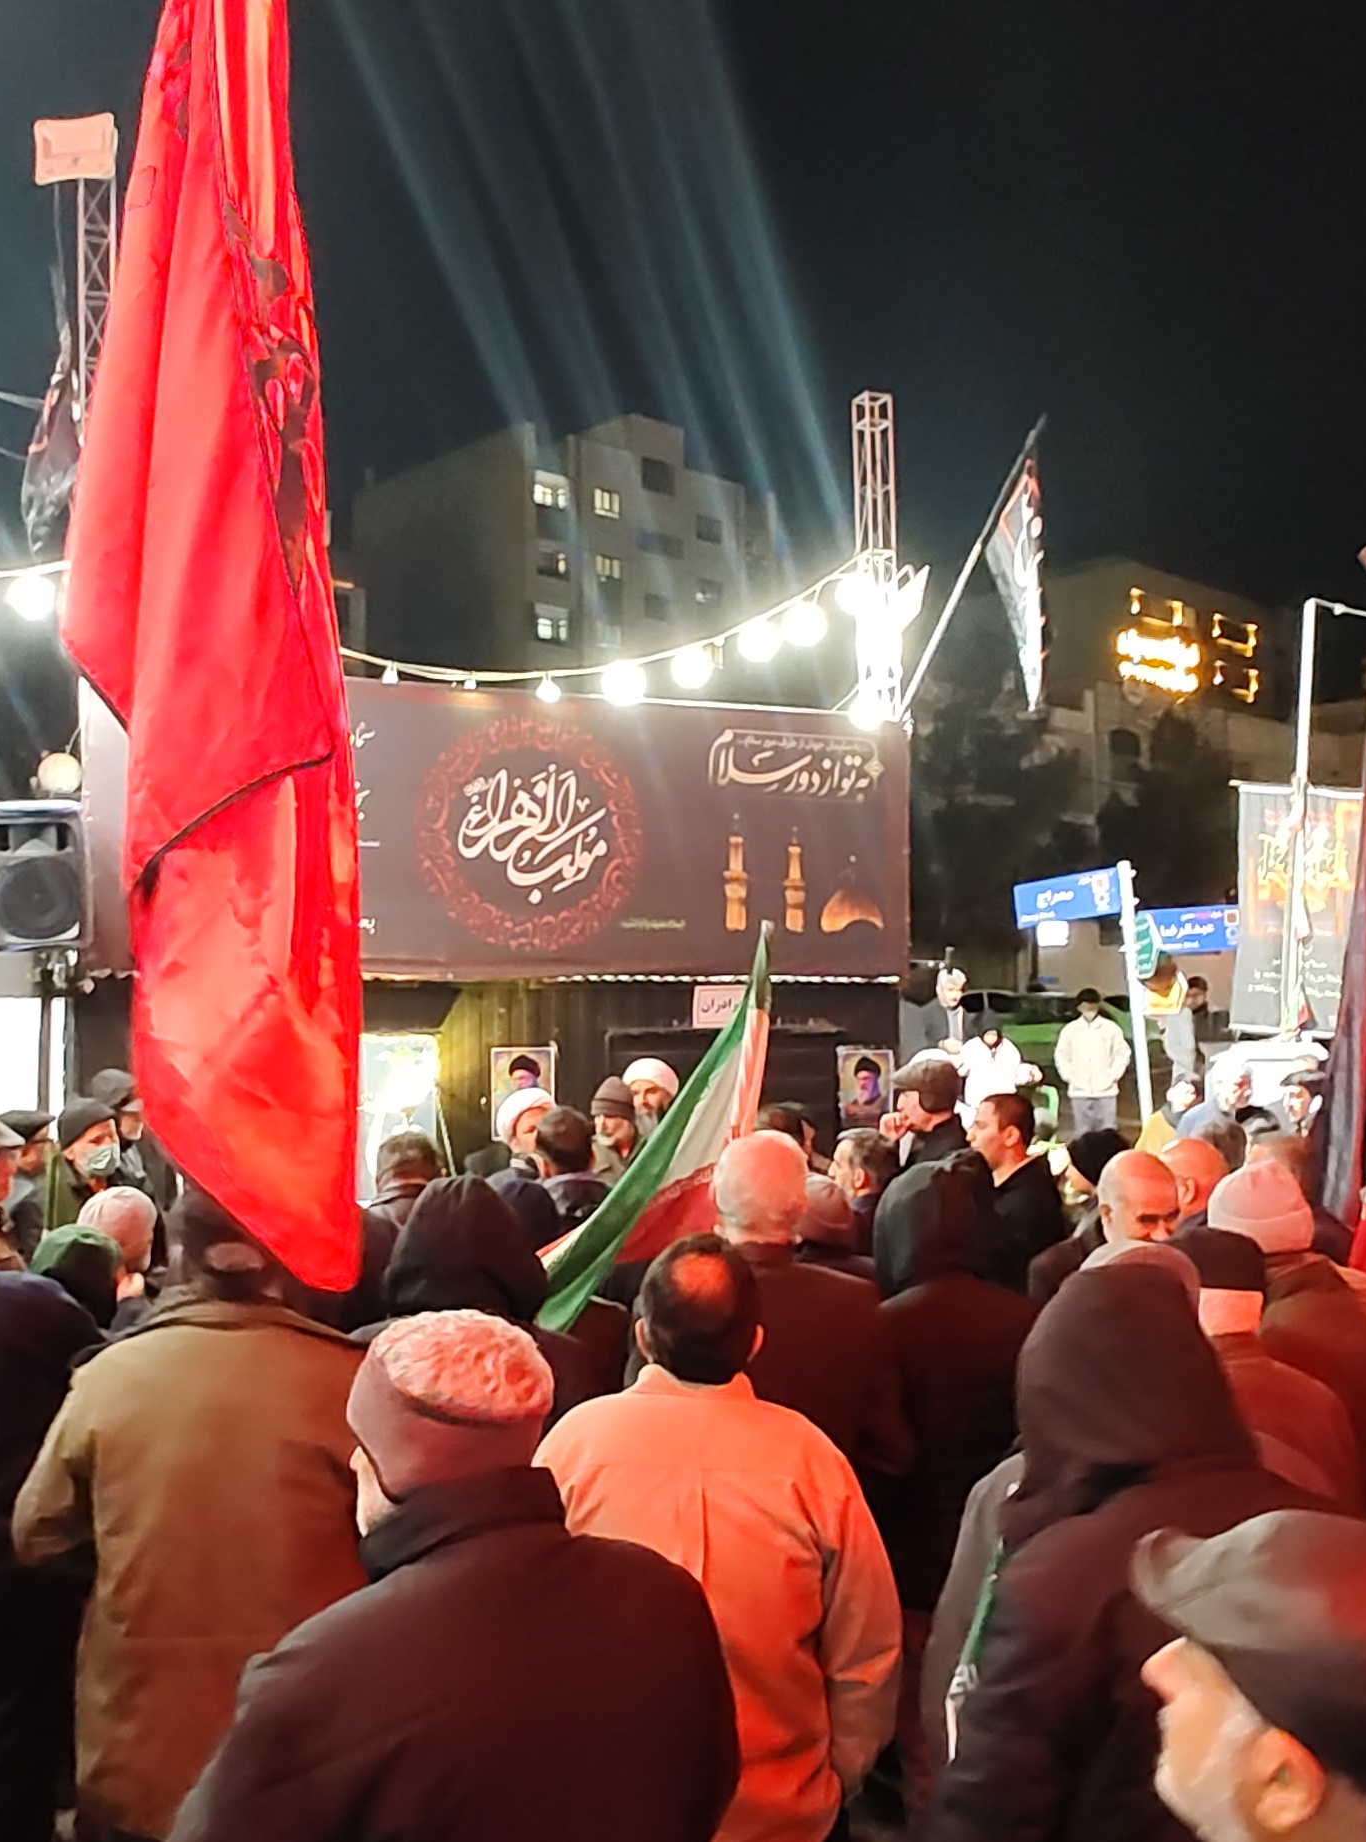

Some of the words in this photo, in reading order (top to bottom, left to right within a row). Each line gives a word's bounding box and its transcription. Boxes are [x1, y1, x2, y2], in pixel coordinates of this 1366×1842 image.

[708, 729, 813, 793] سلام
[783, 770, 821, 794] دور
[818, 758, 841, 797] از
[837, 754, 863, 797] تو
[855, 776, 871, 803] به
[1036, 889, 1075, 910] معراج
[1159, 923, 1215, 940] عبدالرضا
